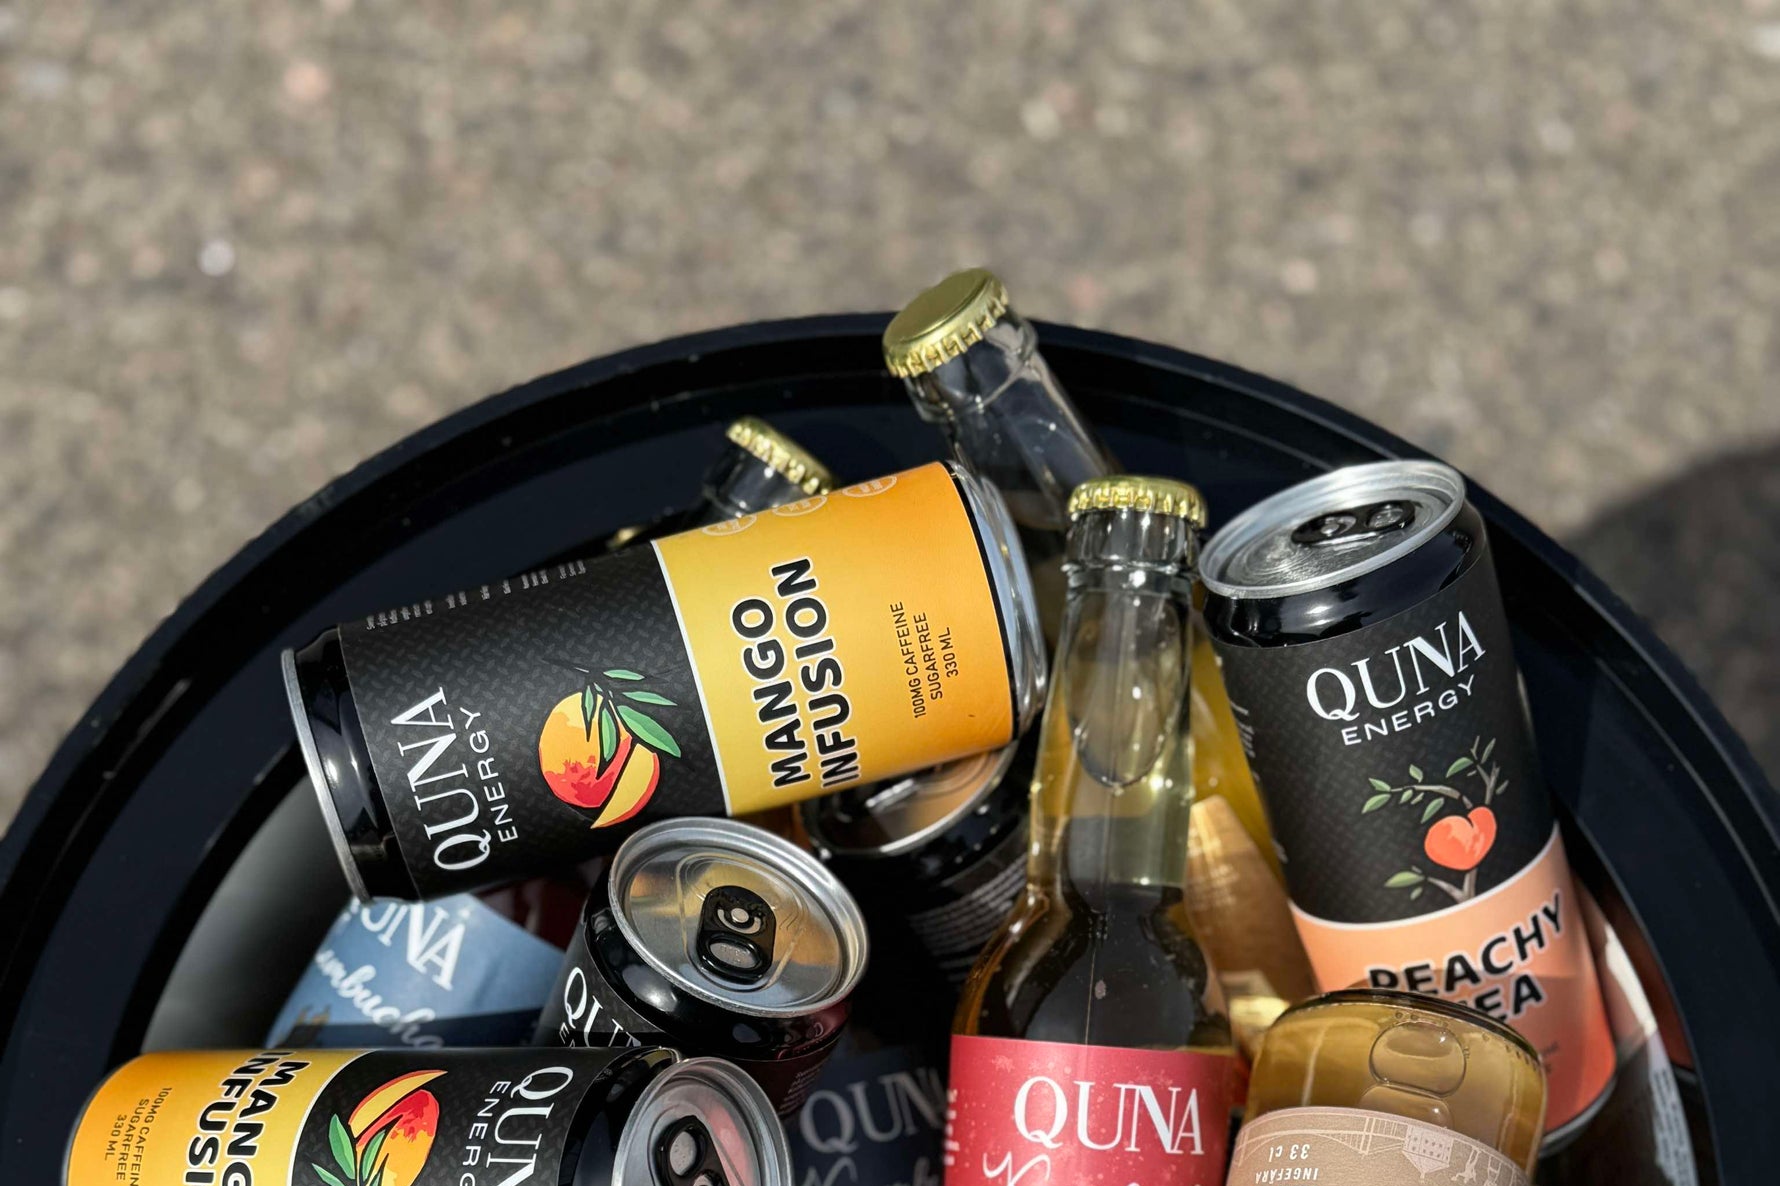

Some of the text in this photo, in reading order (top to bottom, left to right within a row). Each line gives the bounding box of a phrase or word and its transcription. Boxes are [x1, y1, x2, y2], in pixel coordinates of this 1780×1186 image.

[732, 598, 810, 787] MANGO
[771, 558, 859, 787] INFUSION
[890, 602, 926, 718] 100MG CAFFEINE
[914, 612, 942, 700] SUGARFREE
[938, 627, 959, 677] 330 ML
[1306, 611, 1487, 722] QUNA
[1341, 674, 1475, 745] ENERGY
[391, 687, 491, 870] QUNA
[460, 706, 519, 843] ENERGY
[347, 901, 465, 991] UNA
[1461, 974, 1543, 1021] EA
[104, 1114, 128, 1161] 330 ML
[116, 1098, 149, 1180] SUGARFREE
[144, 1087, 172, 1124] 100MG
[800, 1068, 948, 1153] QUN
[1014, 1076, 1204, 1155] QUNA
[1255, 1168, 1319, 1184] INGEFÄRA
[1290, 1144, 1310, 1160] 33
